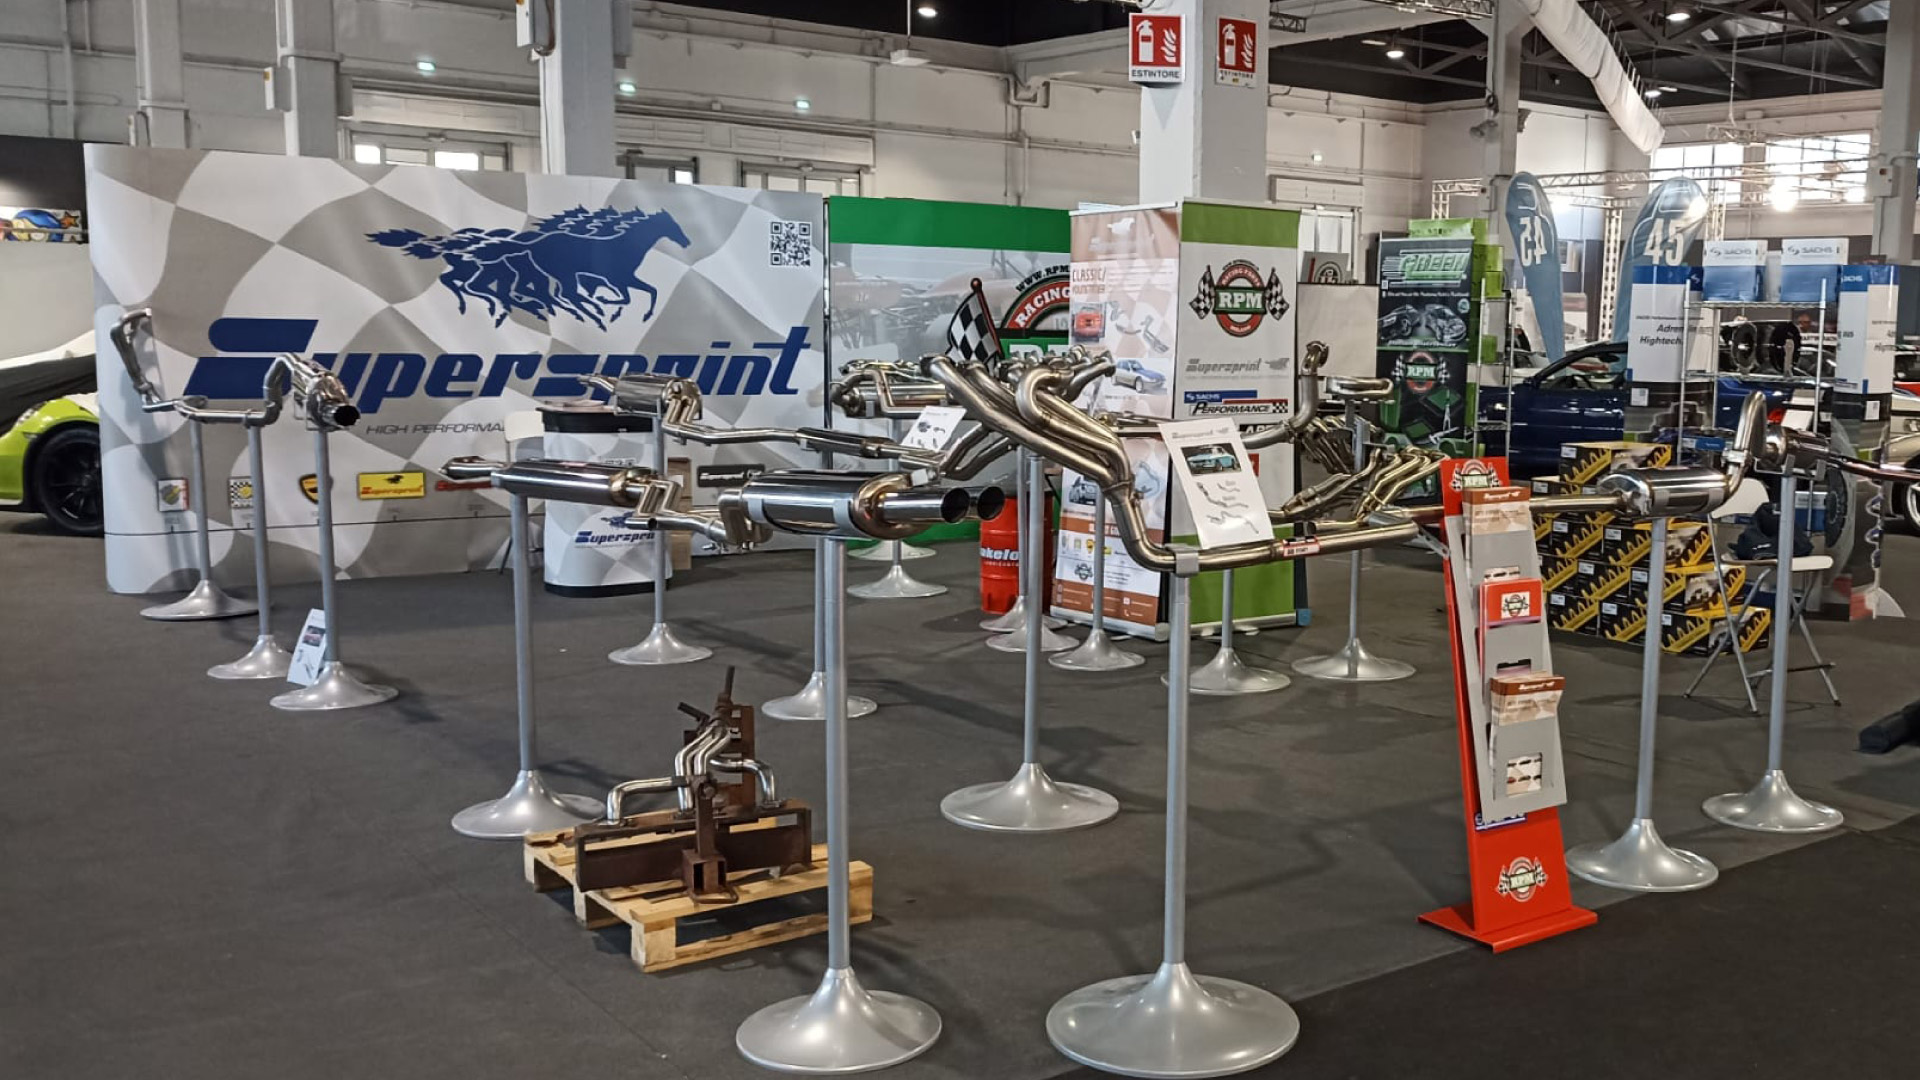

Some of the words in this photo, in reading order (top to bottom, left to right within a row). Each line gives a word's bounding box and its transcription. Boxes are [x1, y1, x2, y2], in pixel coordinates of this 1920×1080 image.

[1131, 69, 1180, 78] ESTINTORE
[1643, 217, 1685, 266] 45
[1802, 246, 1832, 254] SACHS
[1218, 292, 1262, 309] RPM
[1406, 364, 1436, 378] RPM
[1192, 401, 1271, 416] PERFORMANCE
[366, 424, 408, 435] HIGH
